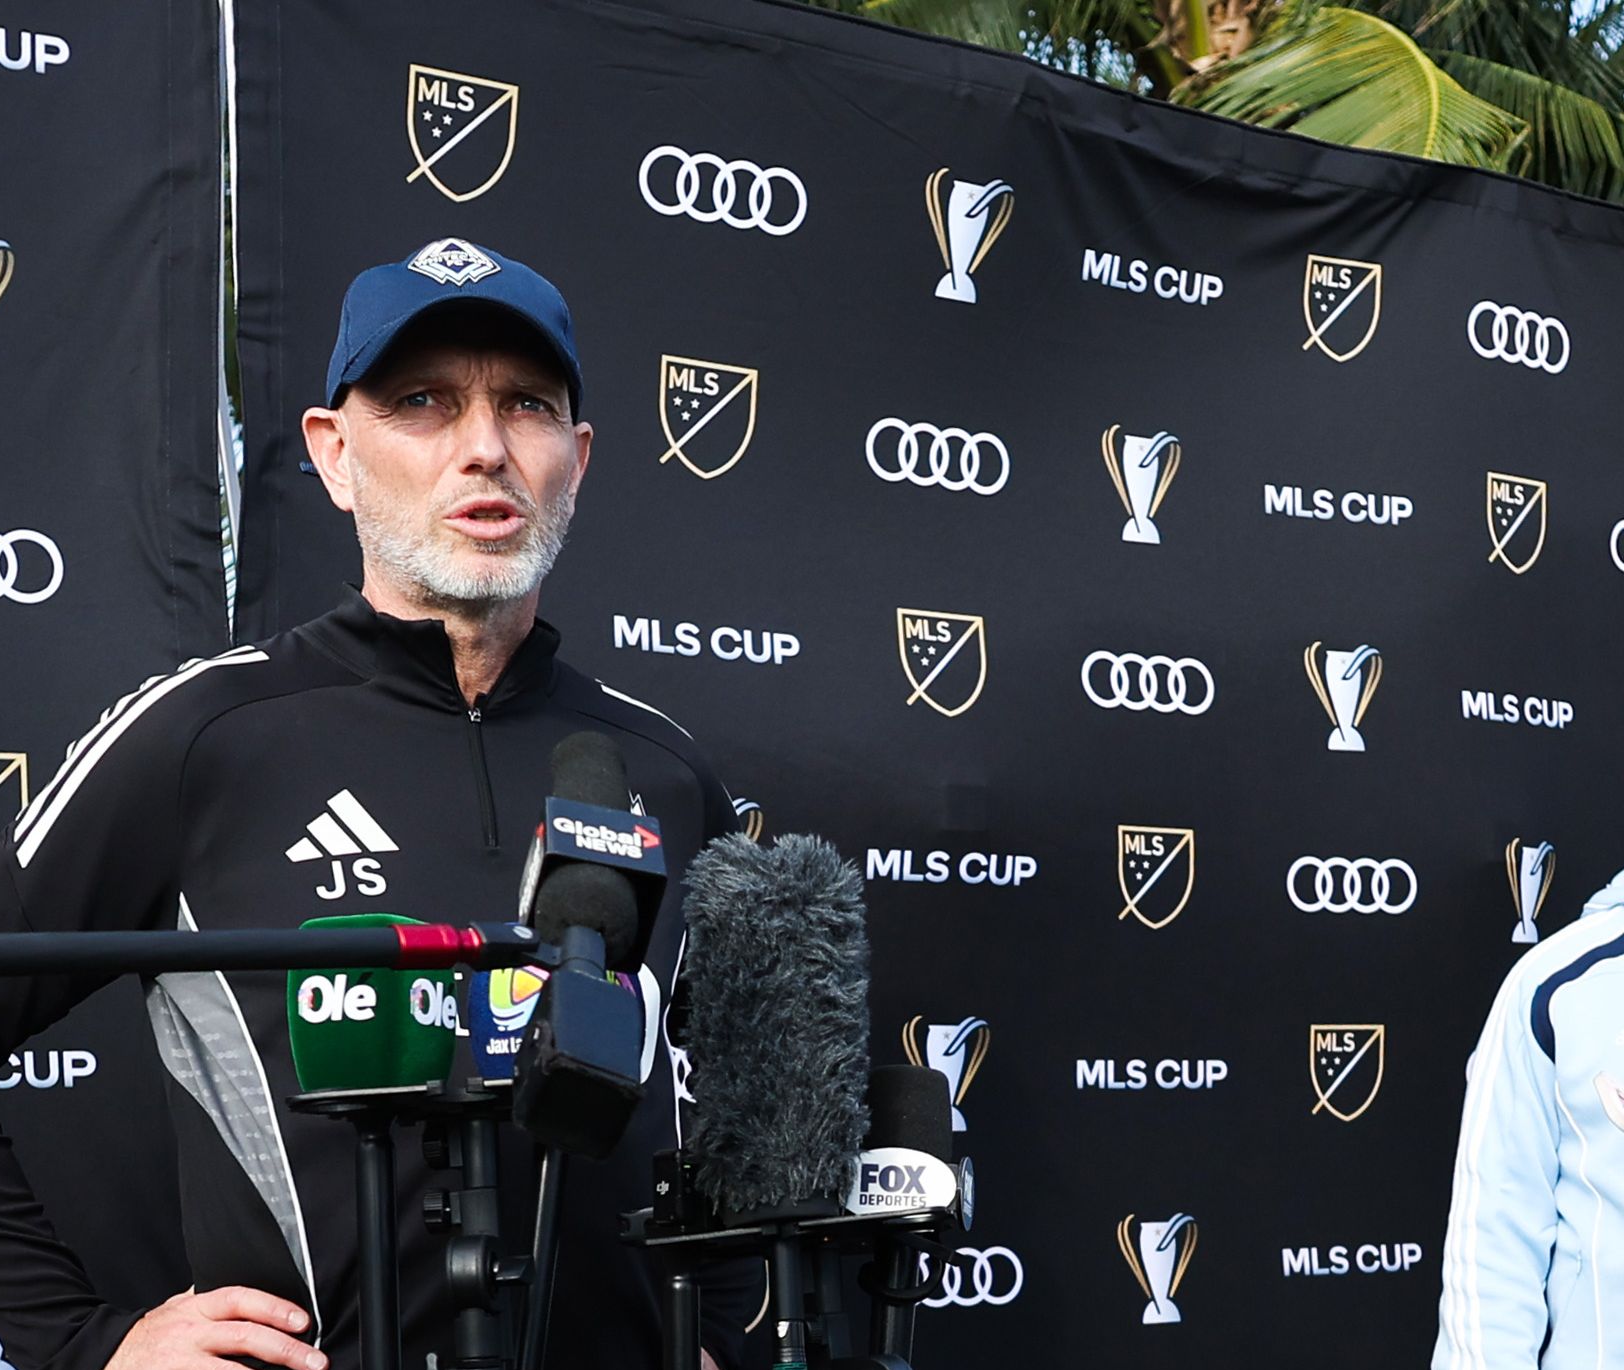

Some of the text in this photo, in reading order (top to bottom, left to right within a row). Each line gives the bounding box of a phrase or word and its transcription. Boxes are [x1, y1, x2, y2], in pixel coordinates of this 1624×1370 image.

[417, 76, 475, 112] MLS
[1082, 248, 1224, 306] MLS CUP
[1311, 263, 1352, 290] MLS
[668, 365, 720, 396] MLS
[1264, 484, 1414, 526] MLS CUP
[1492, 482, 1525, 506] MLS
[613, 614, 801, 665] MLS CUP
[904, 617, 952, 643] MLS
[1461, 690, 1574, 729] MLS CUP
[552, 817, 643, 847] Global
[575, 835, 643, 859] NEWS
[1124, 833, 1165, 857] MLS
[316, 858, 387, 900] JS
[866, 848, 1038, 886] MLS CUP
[486, 1038, 510, 1055] Jax
[1316, 1032, 1356, 1053] MLS
[1076, 1058, 1228, 1090] MLS CUP
[860, 1163, 927, 1194] FOX
[859, 1193, 927, 1208] DEPORTES
[1281, 1242, 1423, 1277] MLS CUP
